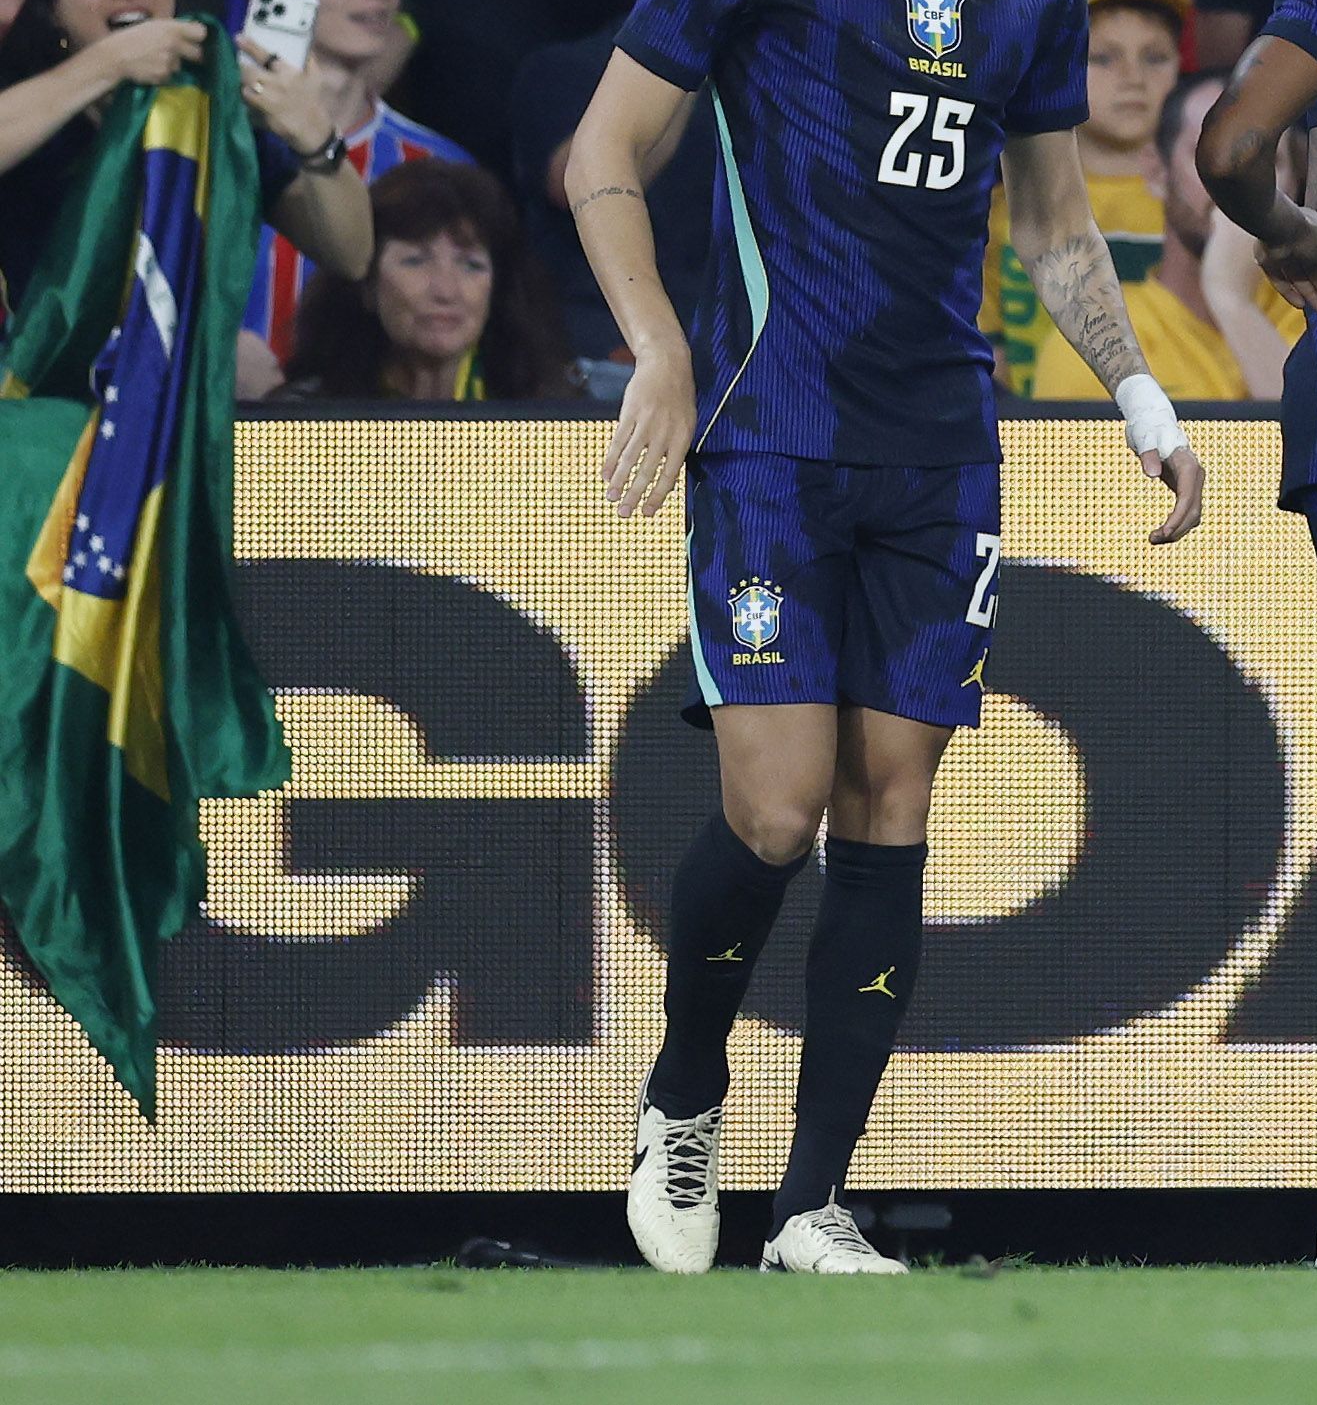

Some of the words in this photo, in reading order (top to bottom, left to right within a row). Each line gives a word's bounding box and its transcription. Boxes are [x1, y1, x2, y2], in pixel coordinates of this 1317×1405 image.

[924, 10, 945, 21] CBF
[909, 57, 967, 78] BRASIL
[877, 91, 976, 191] 25
[965, 532, 1000, 630] 2
[732, 652, 785, 665] BRASIL
